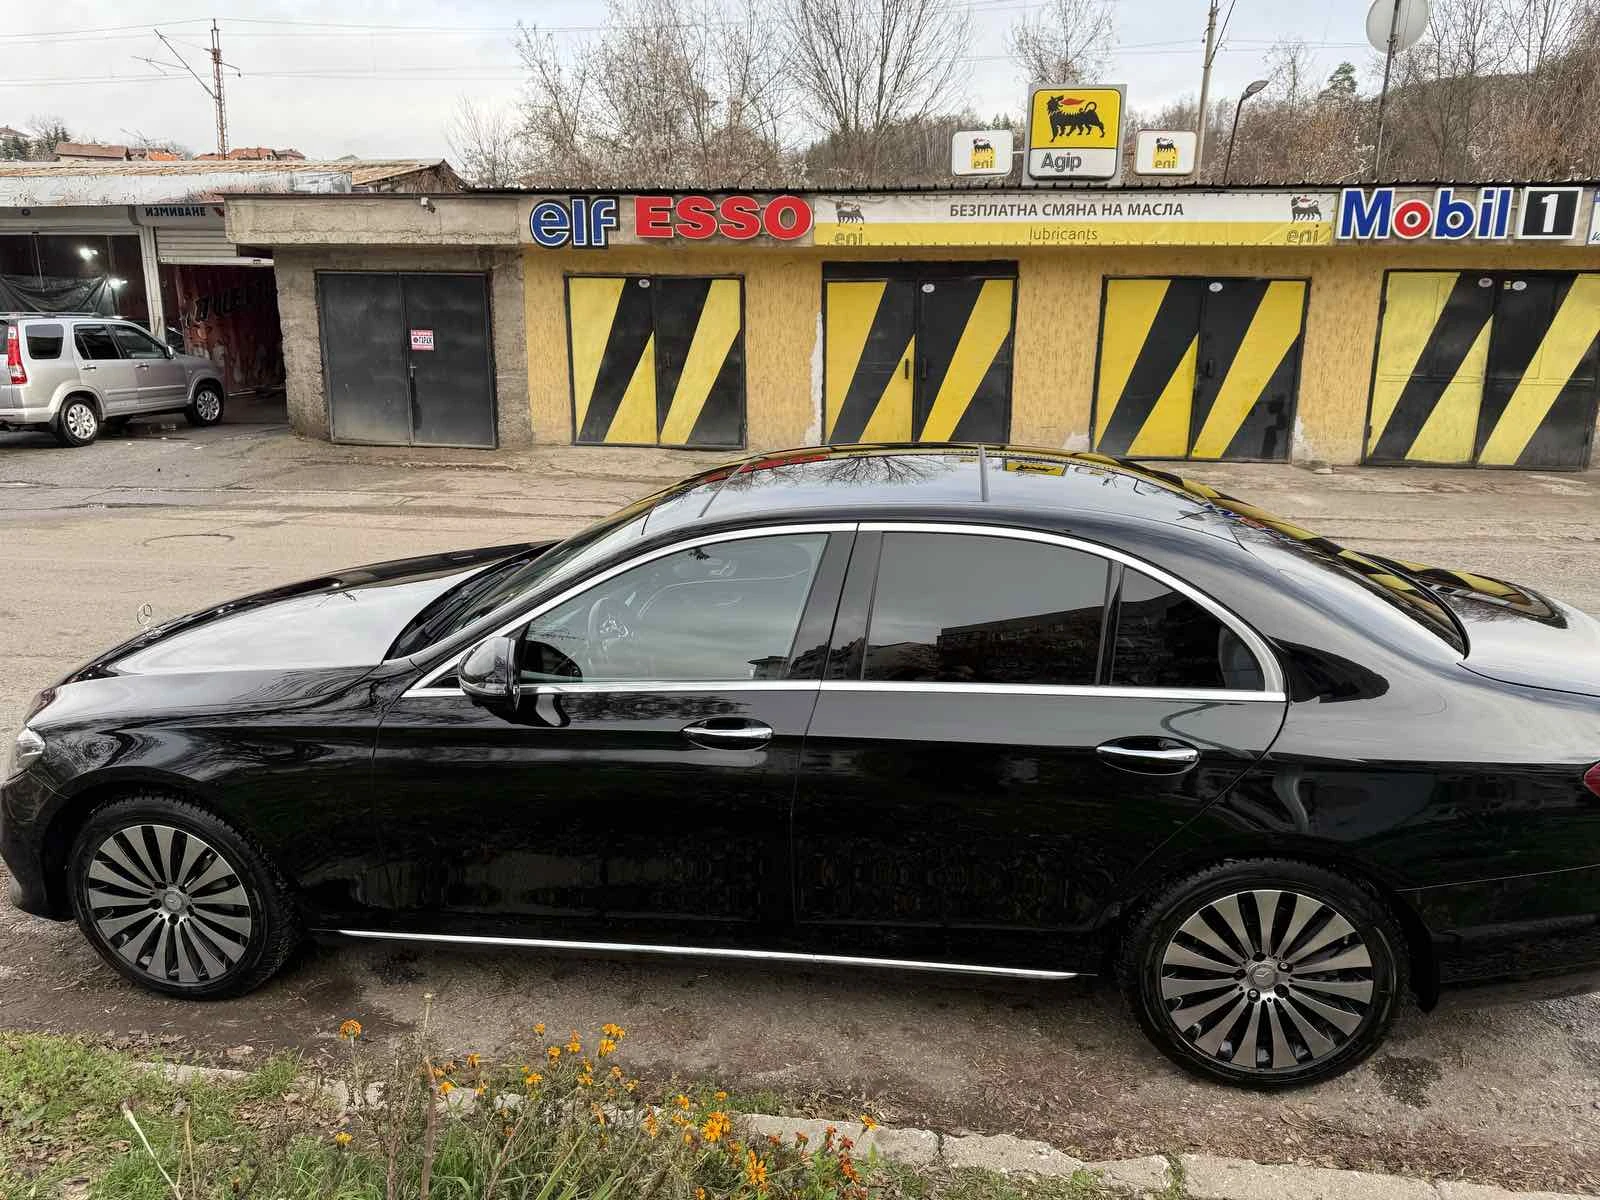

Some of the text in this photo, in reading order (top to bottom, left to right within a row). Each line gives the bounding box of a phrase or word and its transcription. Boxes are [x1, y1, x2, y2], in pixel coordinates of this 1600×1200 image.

[973, 156, 993, 169] eni
[1040, 151, 1082, 172] Agip
[1155, 156, 1176, 169] eni
[145, 206, 206, 217] ИЗМИВАНЕ
[634, 195, 813, 240] ESSO
[950, 203, 1184, 217] БЕЗПЛАТНА СМЯНА НА МАСЛА
[1337, 187, 1560, 240] Mobil 1
[530, 198, 616, 246] elf
[834, 226, 863, 246] eni
[1029, 226, 1098, 241] lubricants
[1286, 224, 1319, 246] eni
